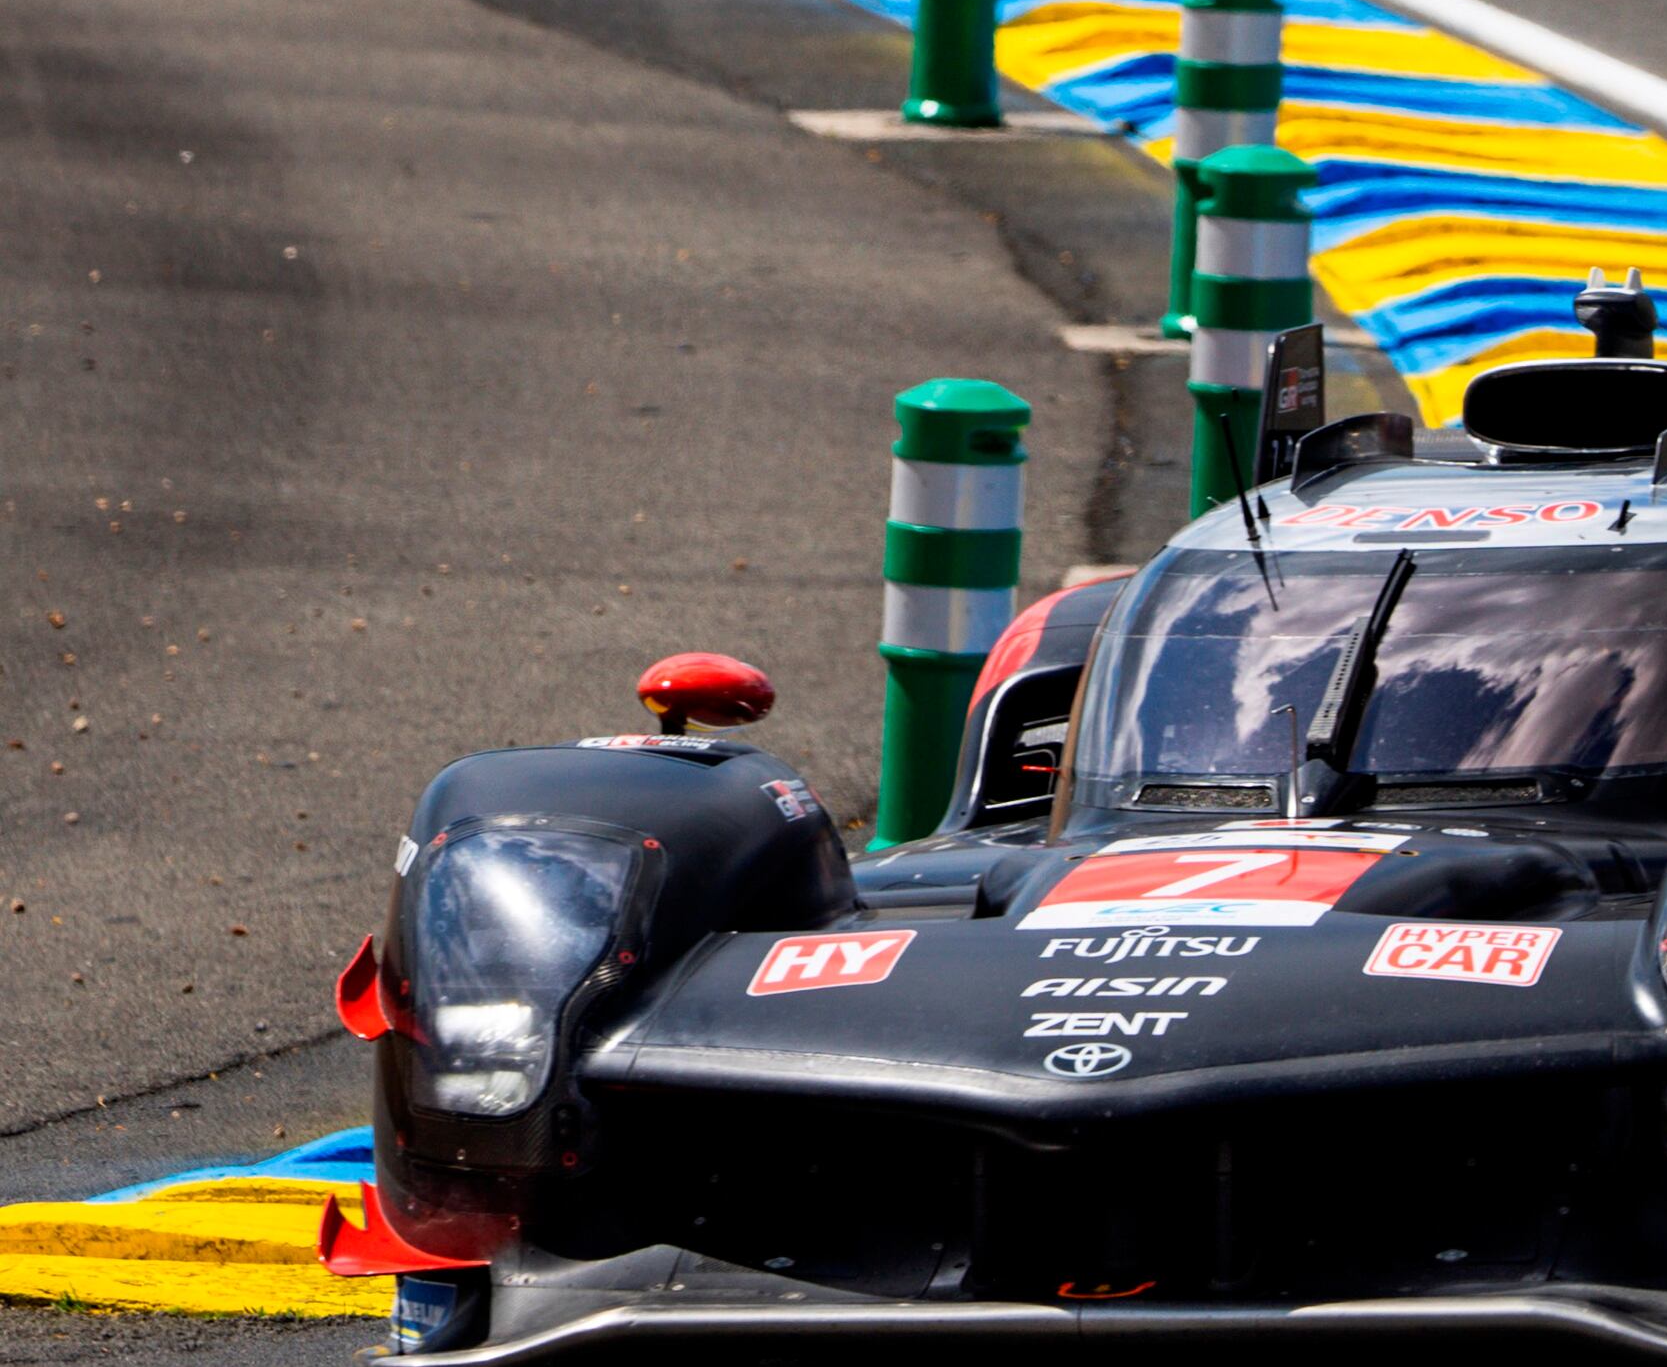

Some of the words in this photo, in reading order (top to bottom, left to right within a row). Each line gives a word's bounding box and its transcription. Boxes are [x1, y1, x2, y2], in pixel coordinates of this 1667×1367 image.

[1277, 500, 1602, 530] DENSO
[1140, 854, 1290, 897] 7
[1038, 925, 1262, 964] FUJITSU
[1398, 928, 1543, 948] HYPER
[763, 938, 901, 983] HY
[1386, 943, 1532, 976] CAR
[1020, 976, 1228, 997] AISIN
[1023, 1011, 1189, 1037] ZENT
